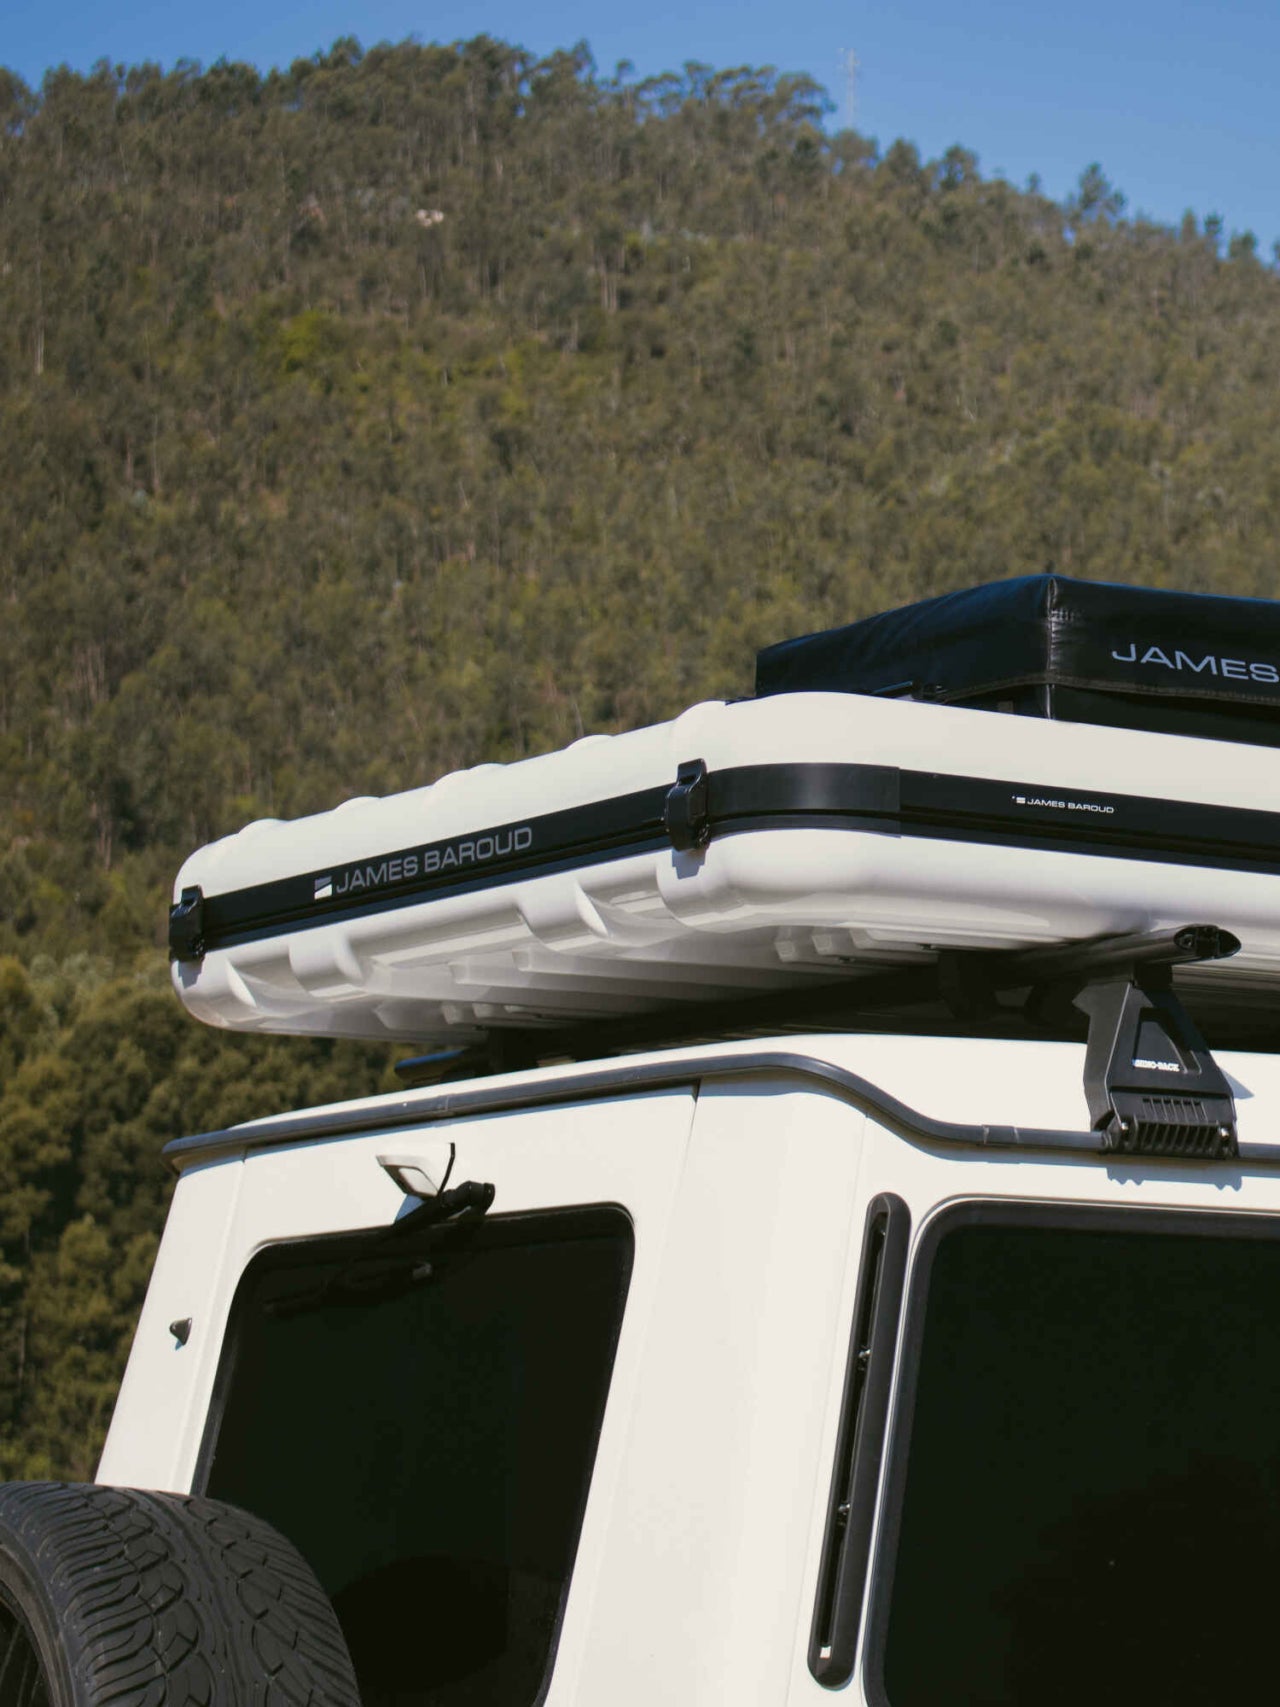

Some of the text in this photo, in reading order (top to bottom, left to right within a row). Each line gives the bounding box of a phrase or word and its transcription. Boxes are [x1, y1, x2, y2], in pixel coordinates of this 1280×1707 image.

[1112, 643, 1280, 683] JAMES
[1027, 799, 1114, 814] JAMES BAROUD
[336, 827, 532, 893] JAMES BAROUD
